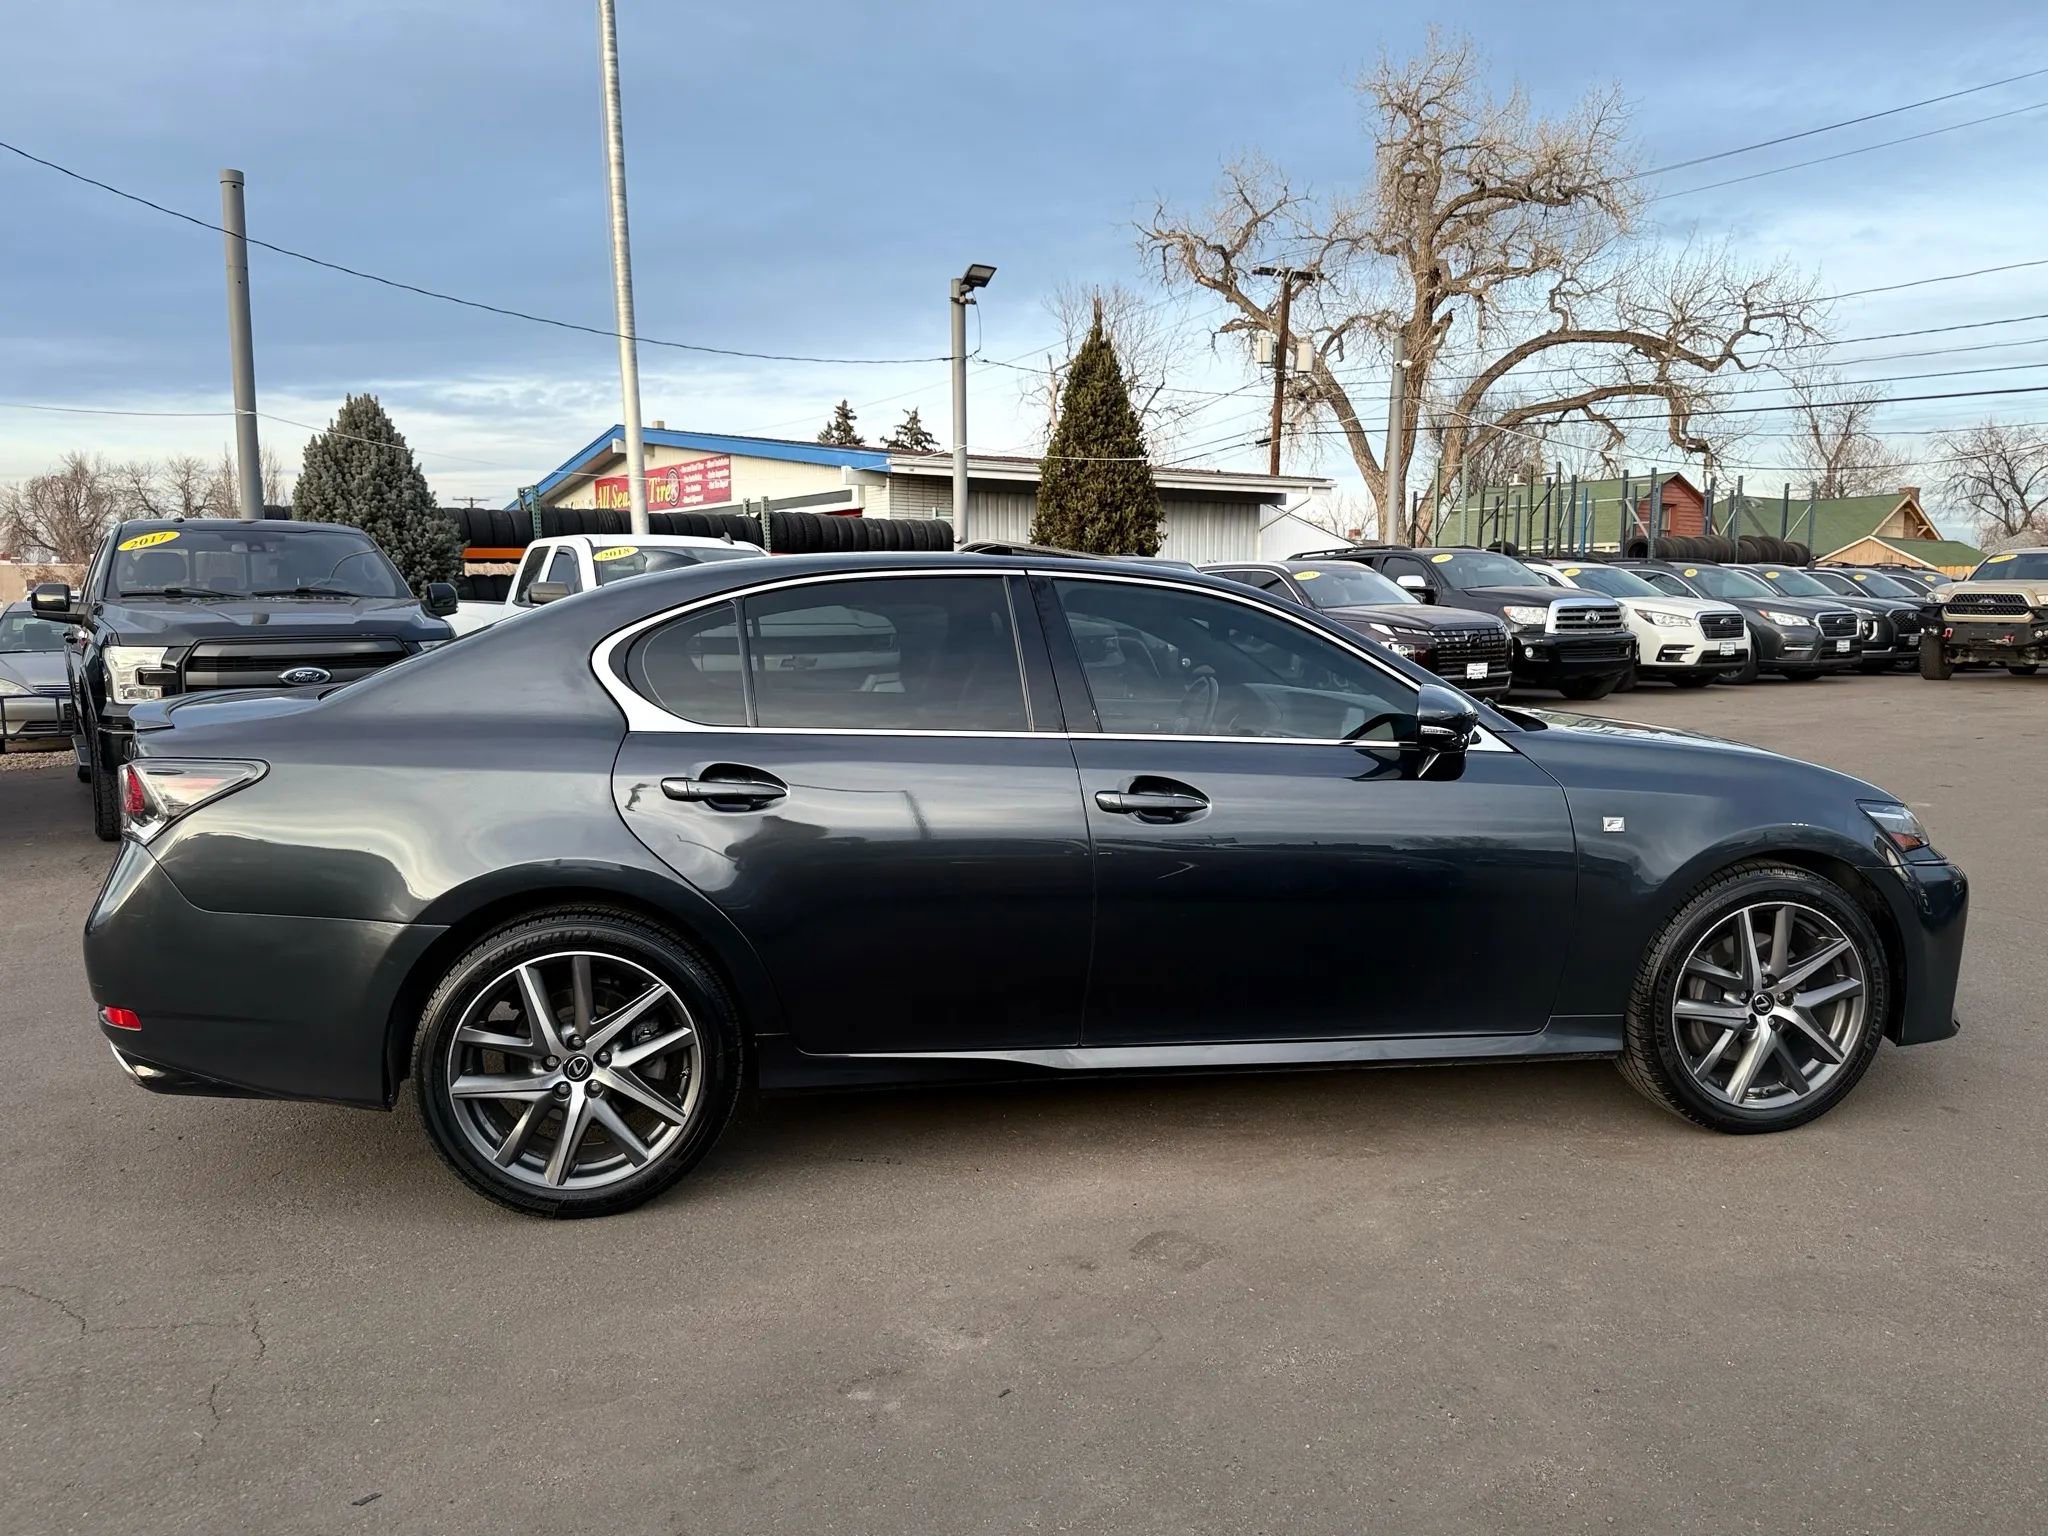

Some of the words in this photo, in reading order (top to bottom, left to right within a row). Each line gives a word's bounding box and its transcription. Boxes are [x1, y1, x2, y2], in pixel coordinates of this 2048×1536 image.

[597, 485, 610, 509] All
[129, 533, 167, 549] 2017
[603, 548, 630, 559] 2018
[293, 671, 320, 682] Ford
[1655, 965, 1673, 1048] MICHELIN
